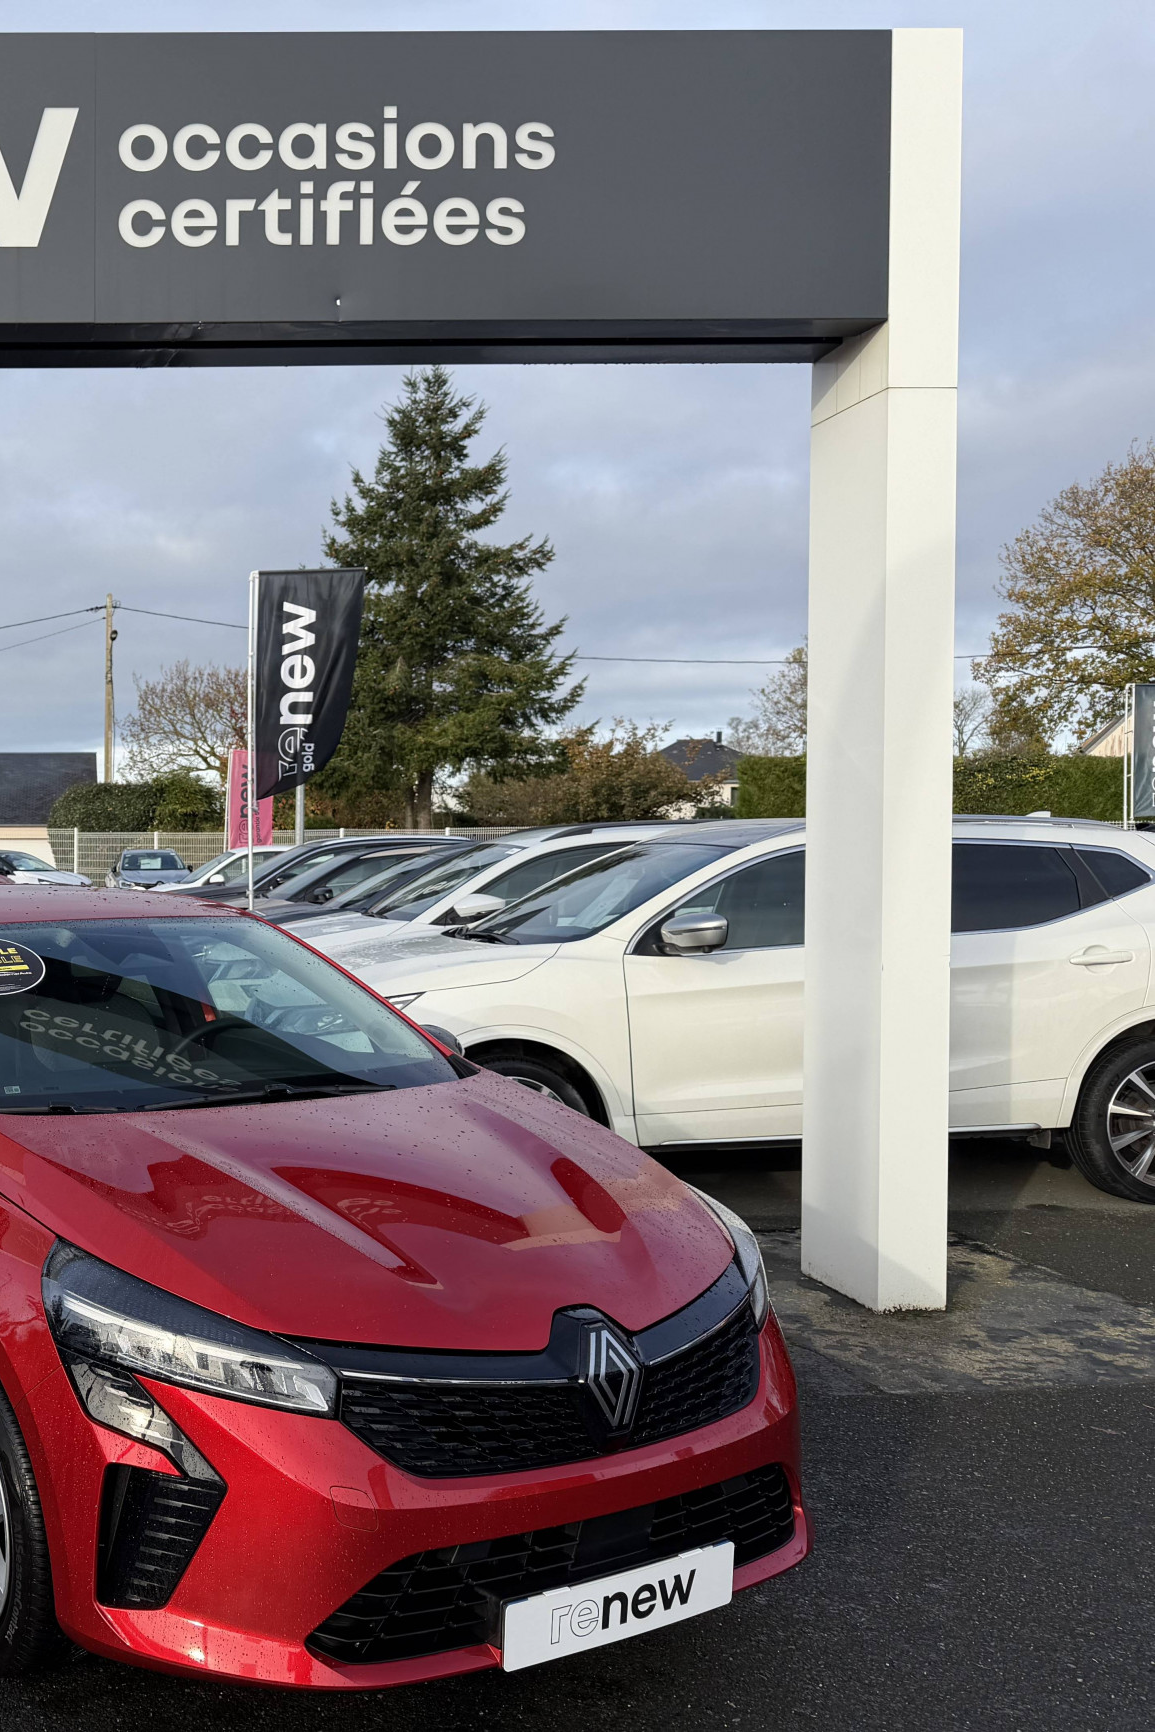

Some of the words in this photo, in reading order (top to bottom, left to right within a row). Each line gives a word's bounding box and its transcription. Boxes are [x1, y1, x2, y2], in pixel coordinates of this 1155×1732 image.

[118, 106, 556, 172] occasions
[118, 181, 527, 248] certifiées
[302, 742, 315, 773] gold
[550, 1568, 697, 1645] renew
